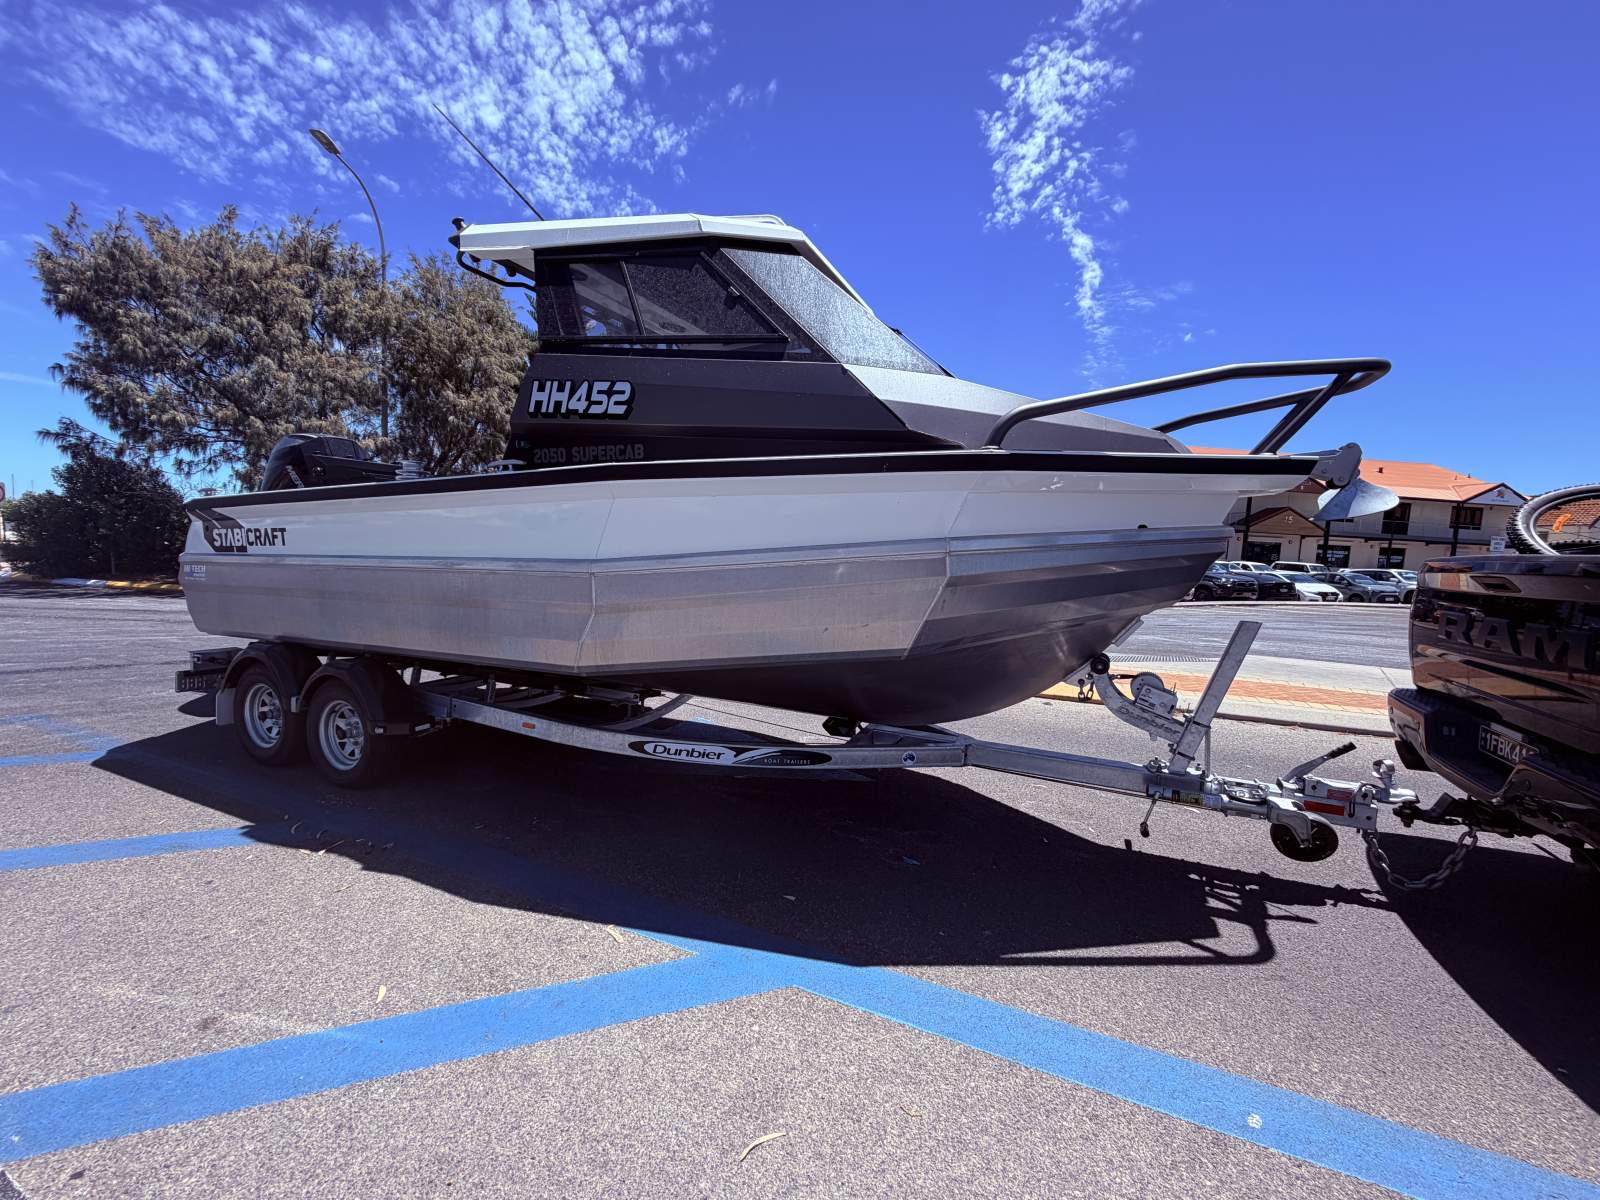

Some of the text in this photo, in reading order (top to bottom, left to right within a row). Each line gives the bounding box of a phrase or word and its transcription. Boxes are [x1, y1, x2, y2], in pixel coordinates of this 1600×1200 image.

[528, 380, 633, 417] HH452
[533, 443, 645, 464] 2050 SUPERCAB
[1437, 609, 1594, 672] RAM
[652, 744, 725, 760] Dunbier
